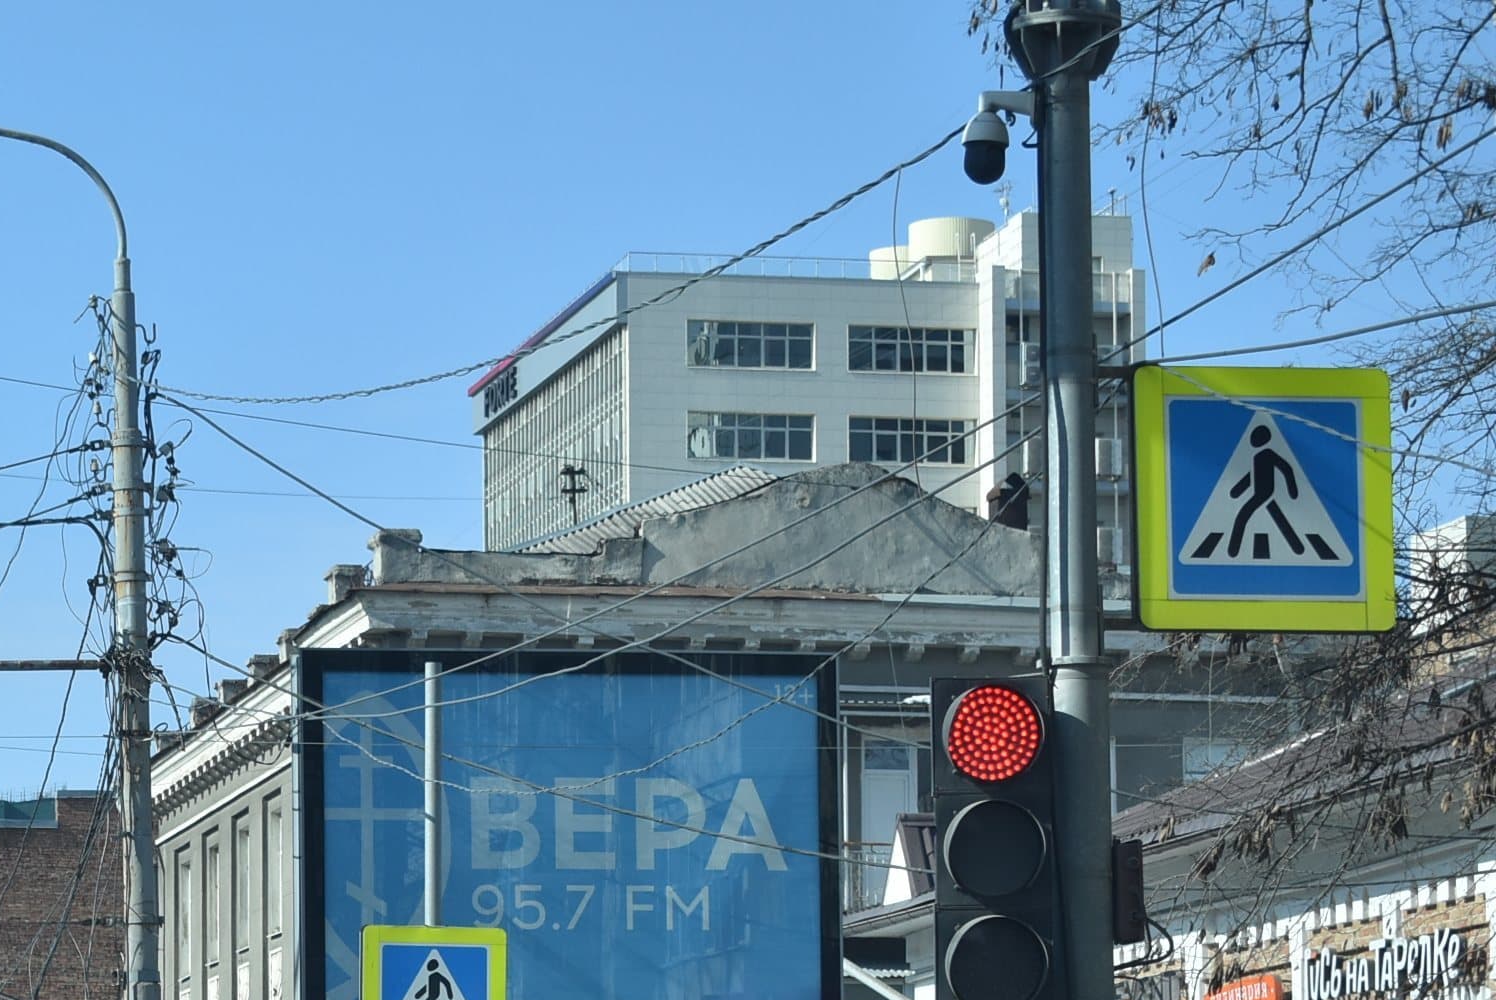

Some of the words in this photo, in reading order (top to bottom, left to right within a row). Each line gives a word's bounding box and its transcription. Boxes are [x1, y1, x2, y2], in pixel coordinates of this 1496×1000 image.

[470, 777, 789, 872] ВЕРА
[471, 885, 596, 932] 95.7
[626, 886, 711, 931] FM
